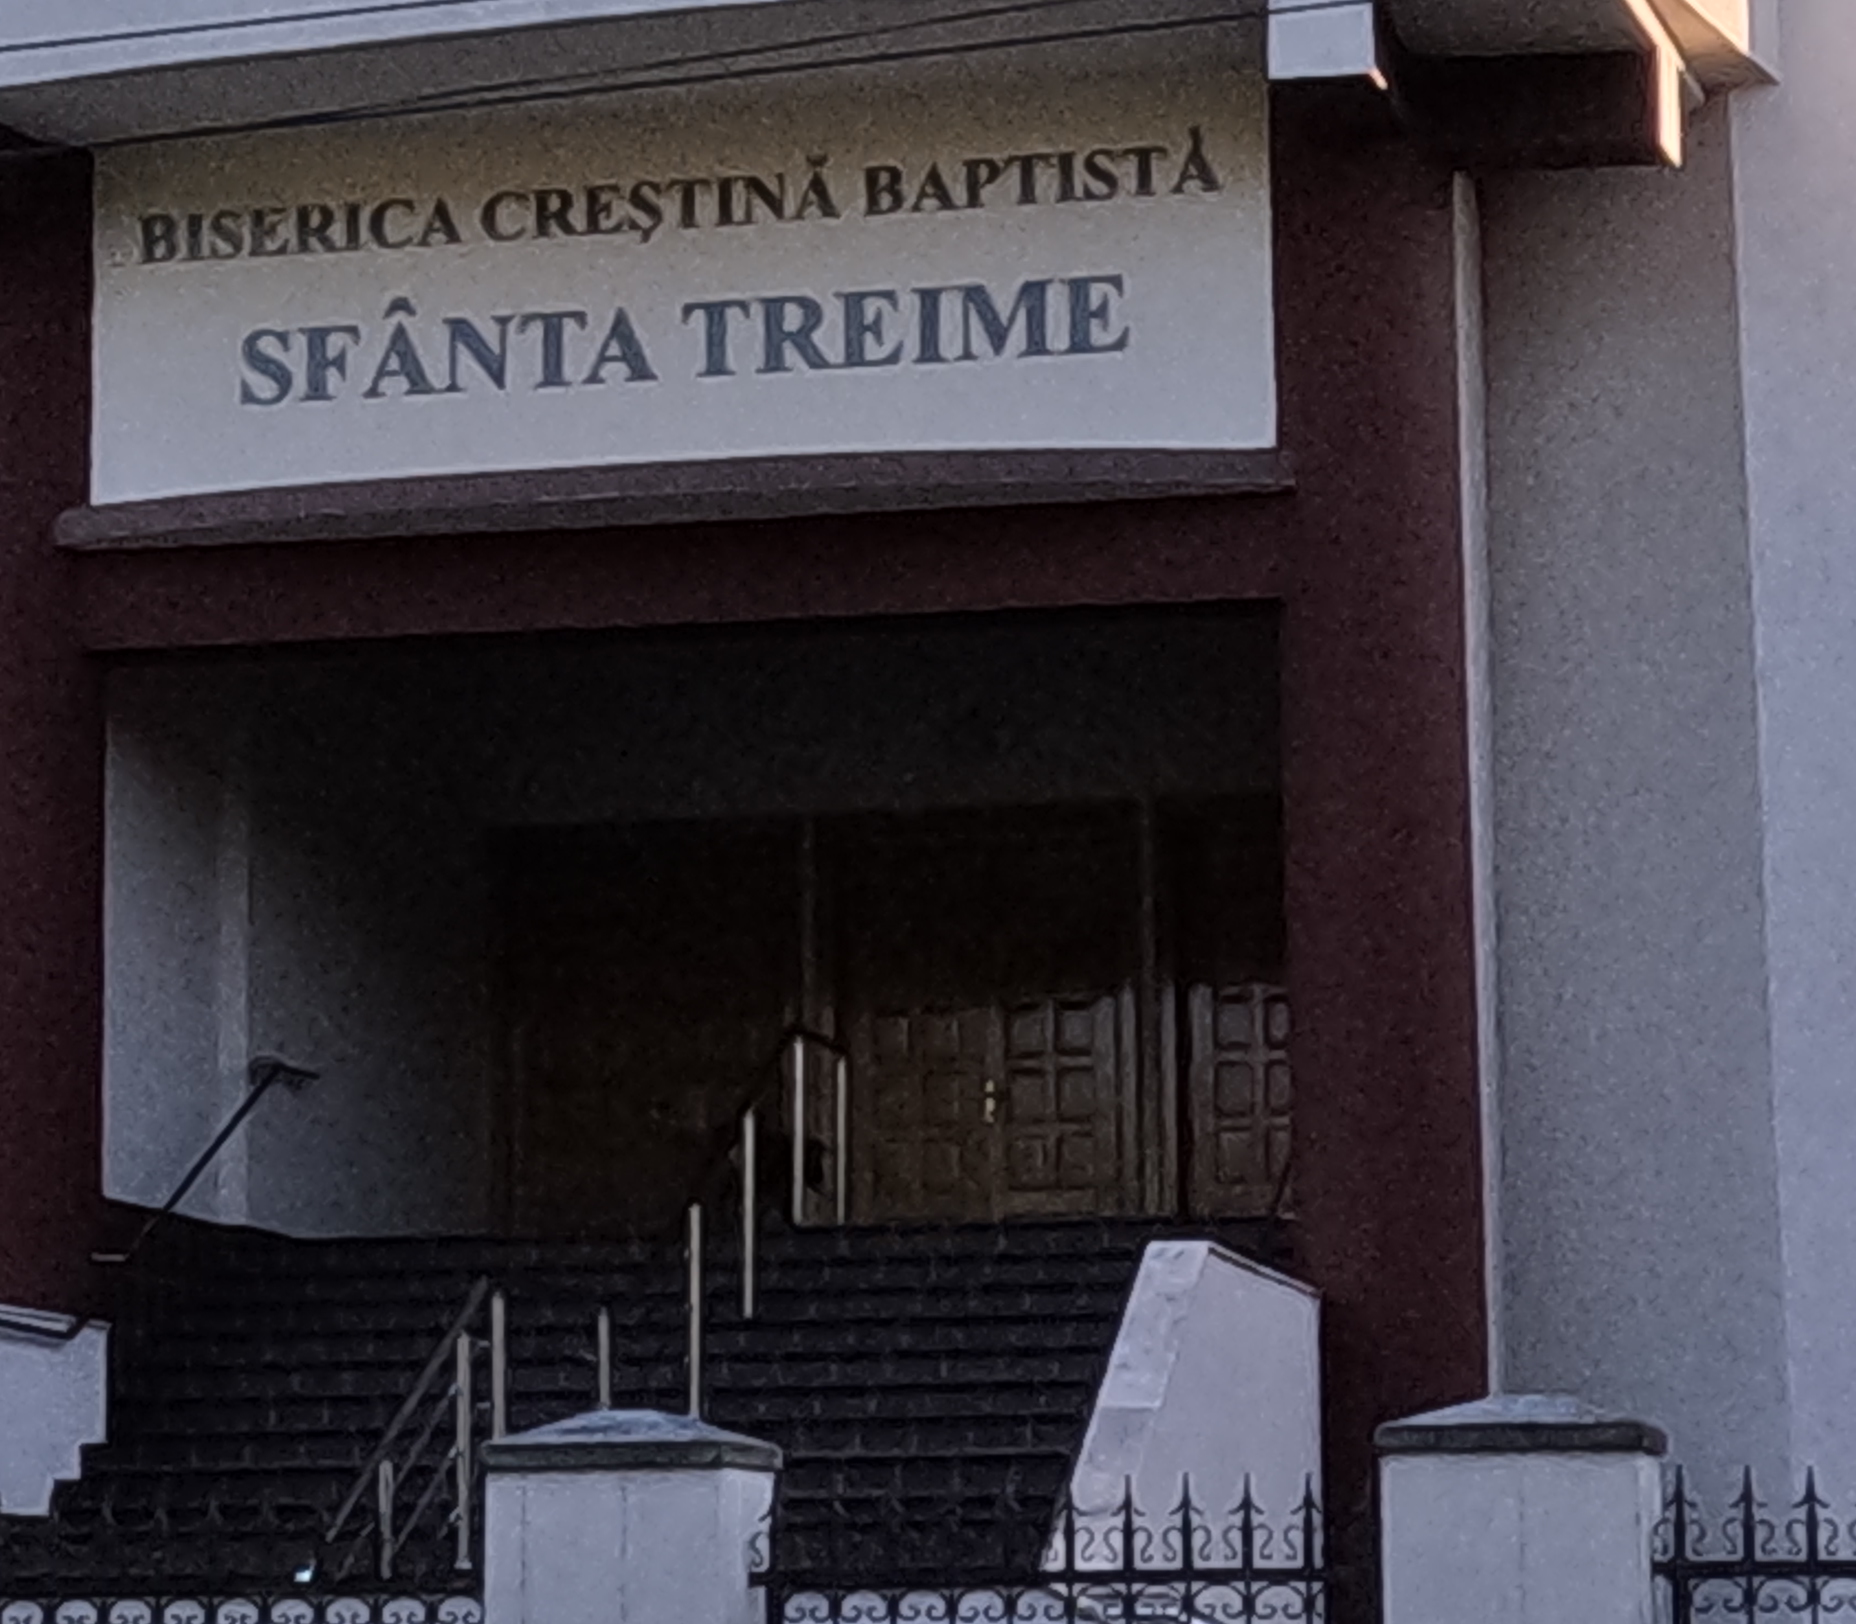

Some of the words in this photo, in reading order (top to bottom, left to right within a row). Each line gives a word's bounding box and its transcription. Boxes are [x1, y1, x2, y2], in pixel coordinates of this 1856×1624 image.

[140, 197, 462, 264] BISERICA
[240, 296, 658, 406] SFÂNTA
[681, 274, 1130, 377] TREIME
